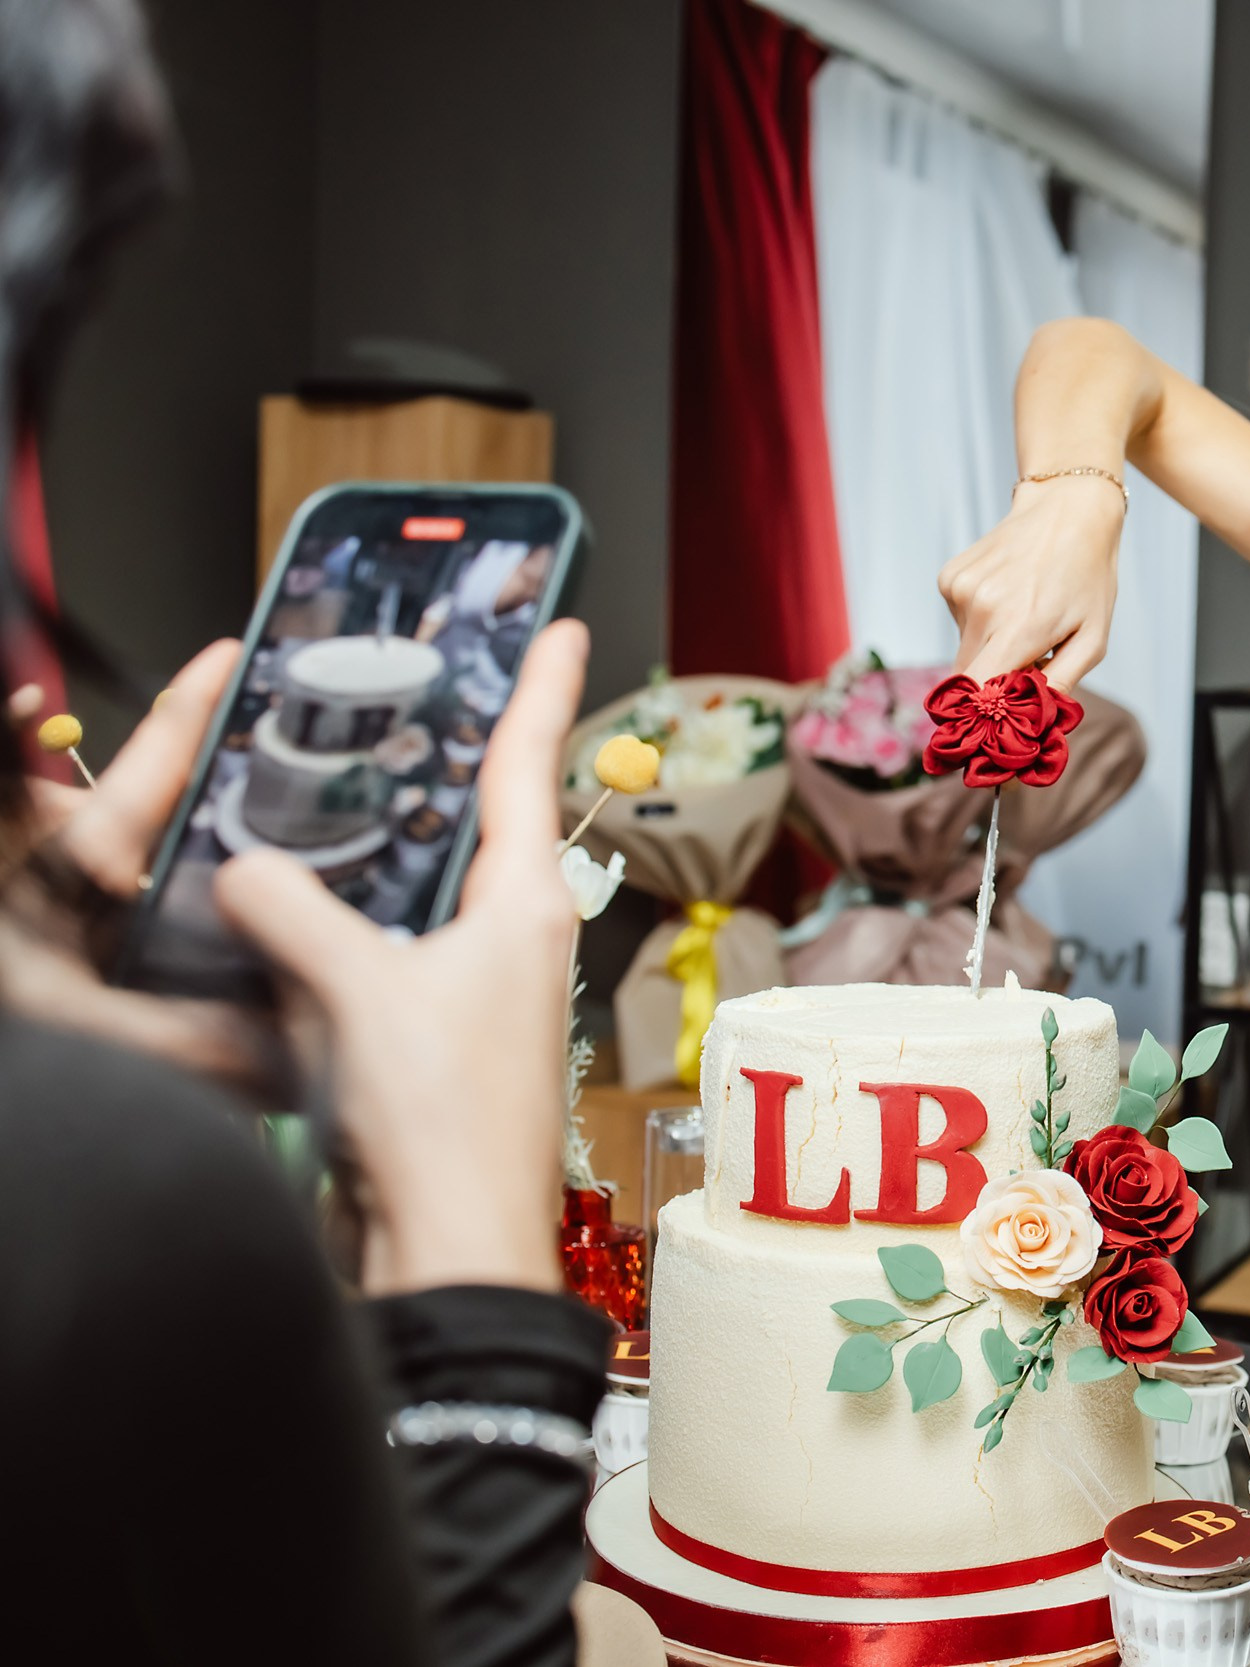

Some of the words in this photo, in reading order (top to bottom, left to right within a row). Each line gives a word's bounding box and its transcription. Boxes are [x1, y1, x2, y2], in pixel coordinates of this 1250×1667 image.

[740, 1067, 988, 1225] LB
[612, 1341, 651, 1360] L
[1133, 1510, 1237, 1554] LB
